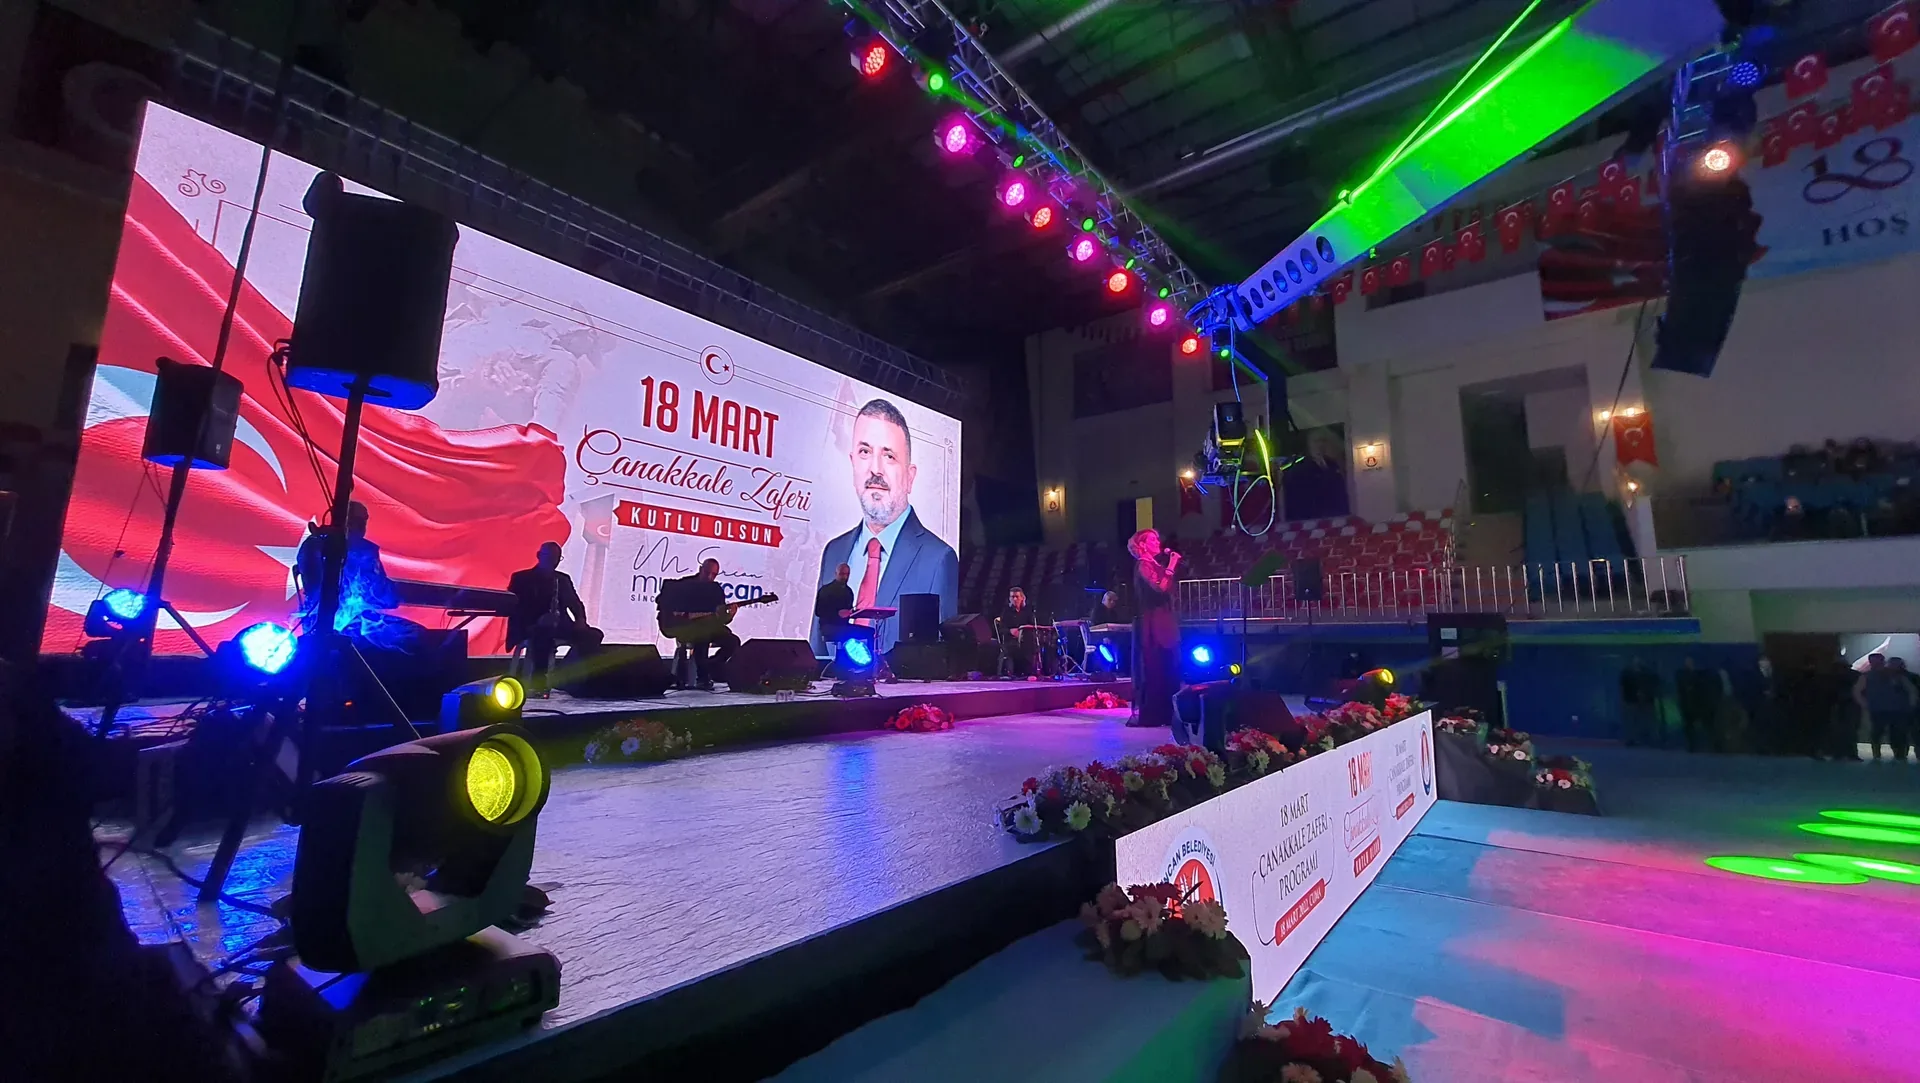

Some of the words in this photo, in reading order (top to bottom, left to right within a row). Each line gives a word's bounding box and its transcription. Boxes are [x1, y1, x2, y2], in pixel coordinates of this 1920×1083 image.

[640, 375, 680, 434] 18
[691, 389, 779, 459] MART
[576, 424, 734, 496] Çanakkale
[740, 467, 811, 520] Zaferi
[630, 506, 700, 533] KUTLU
[713, 519, 772, 544] OLSUN
[1280, 804, 1289, 828] 18
[1290, 792, 1309, 822] MART
[1259, 827, 1306, 885] ÇANAKKALE
[1279, 849, 1318, 901] PROGRAMI
